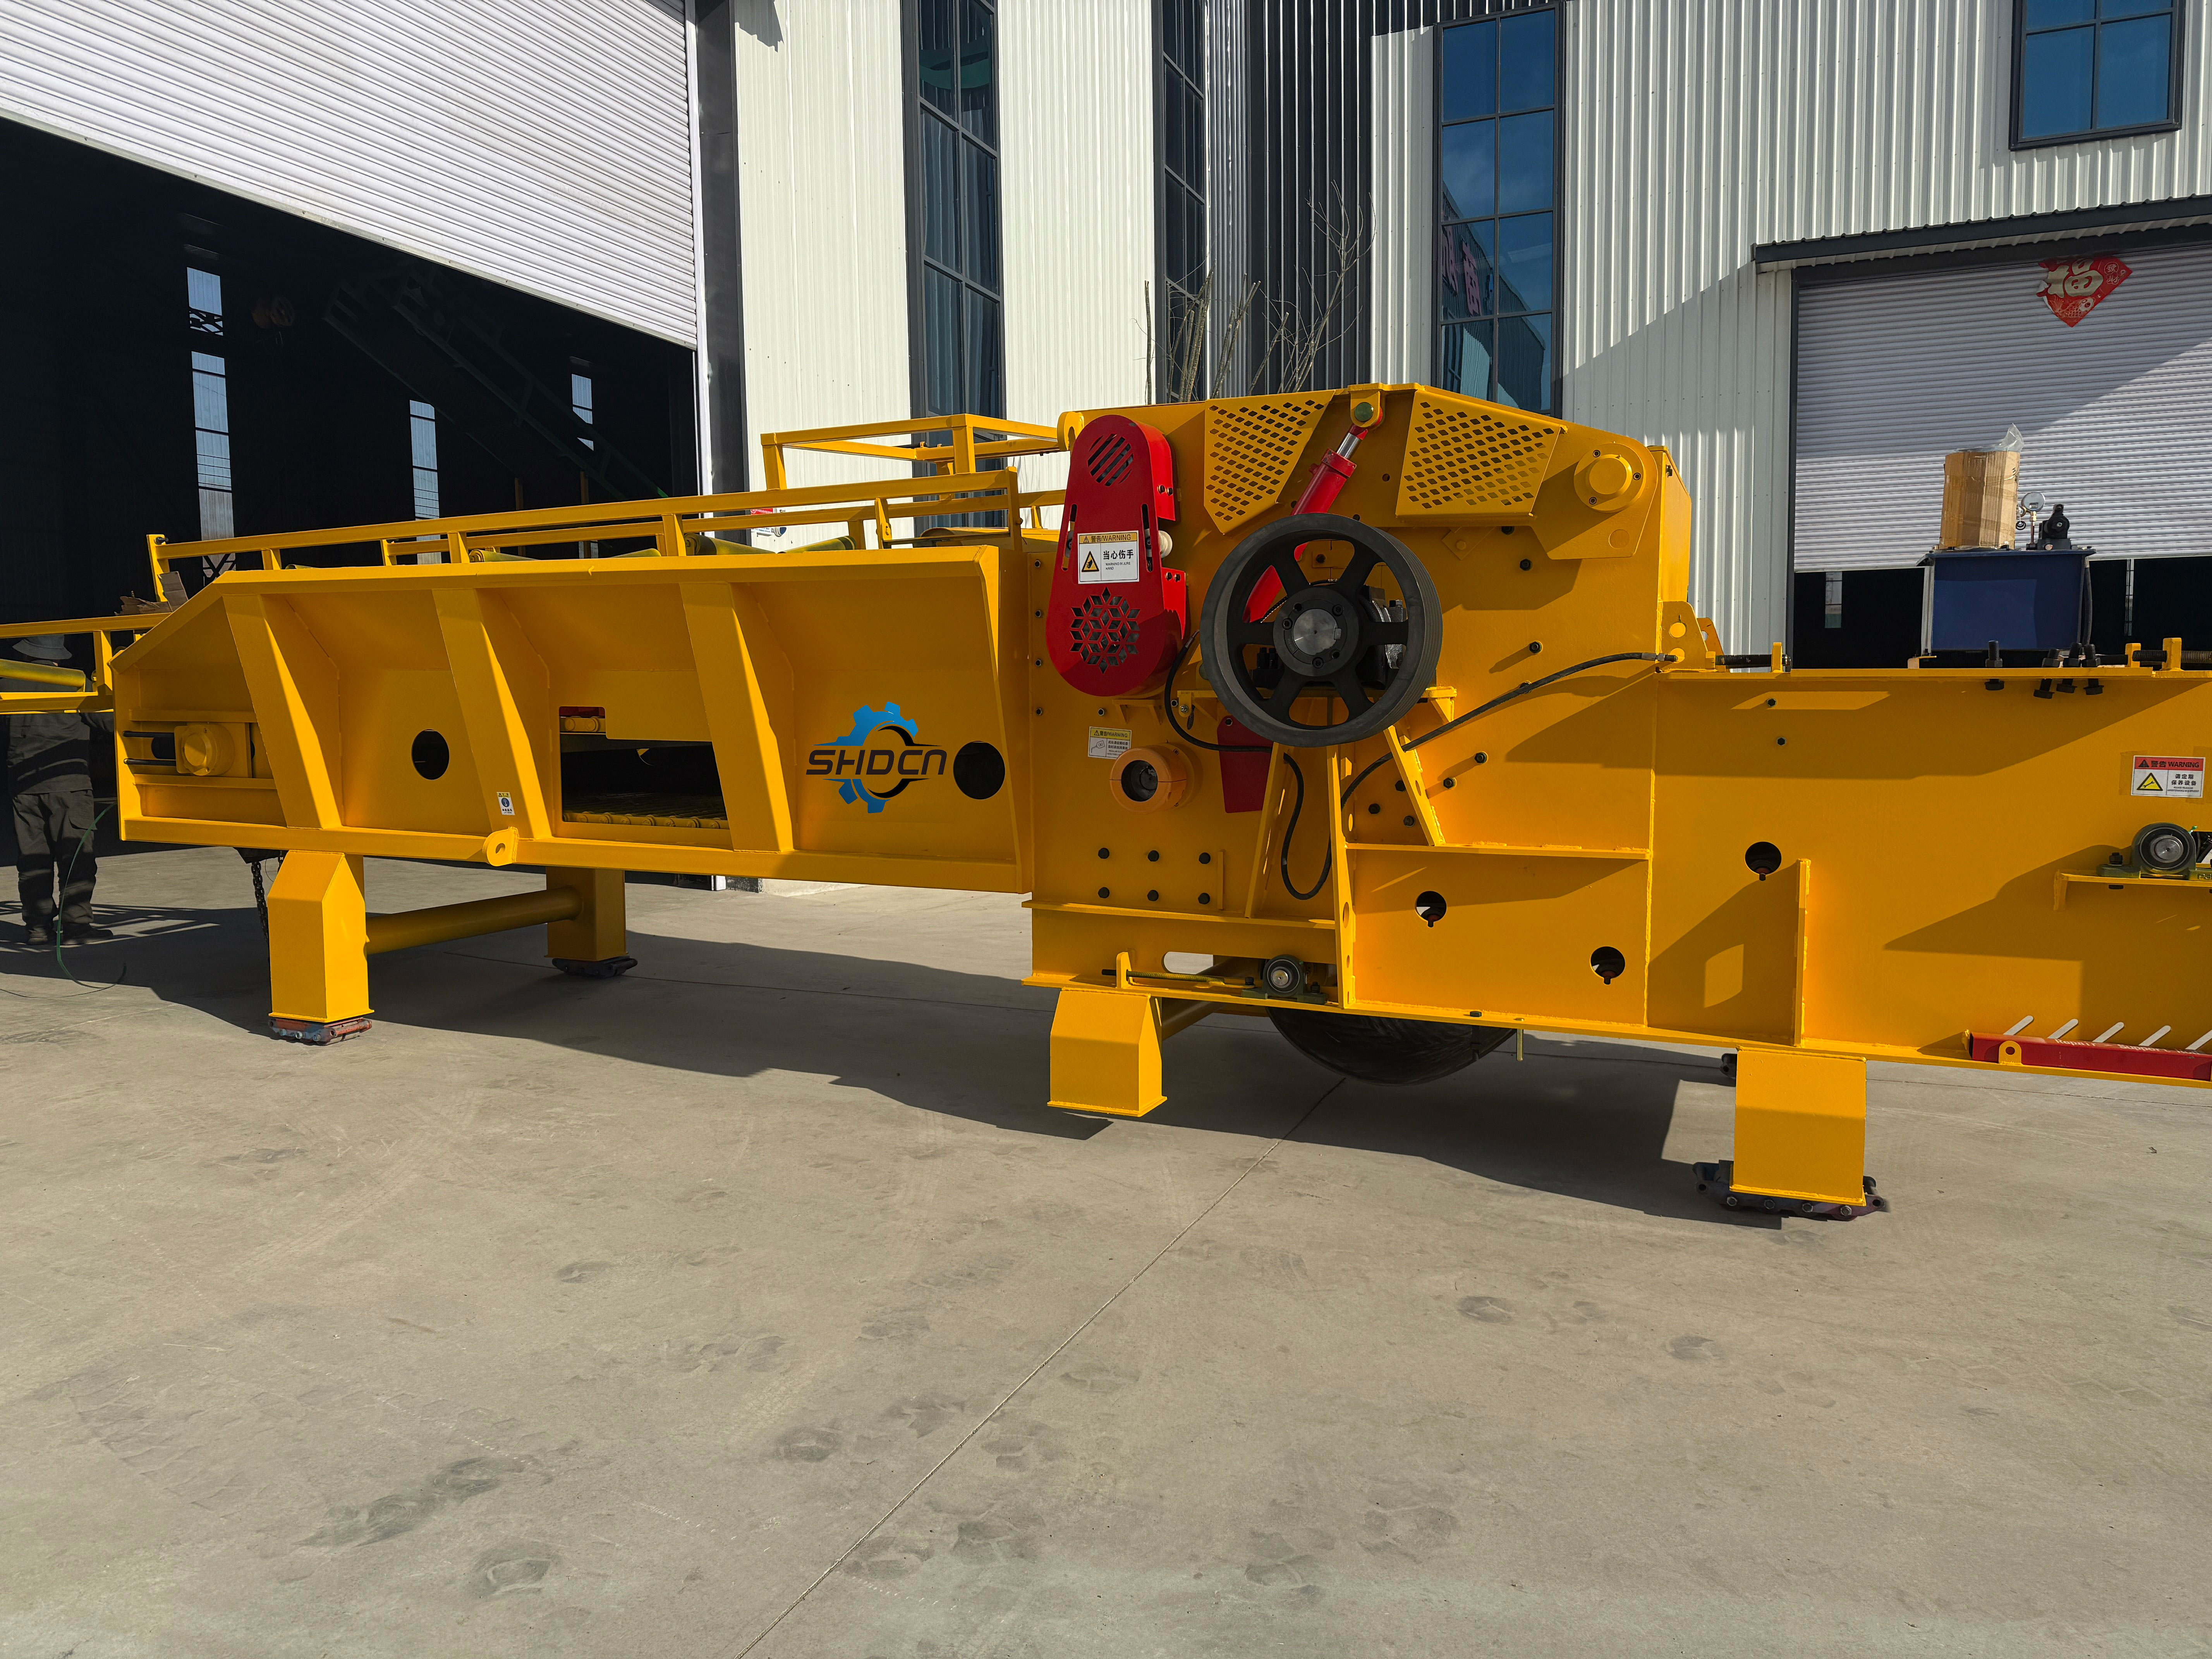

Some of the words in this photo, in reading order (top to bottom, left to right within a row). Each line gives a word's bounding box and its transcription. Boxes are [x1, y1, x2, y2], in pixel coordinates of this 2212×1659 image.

[1103, 549, 1134, 560] 当心伤手
[806, 749, 947, 775] SHDCN
